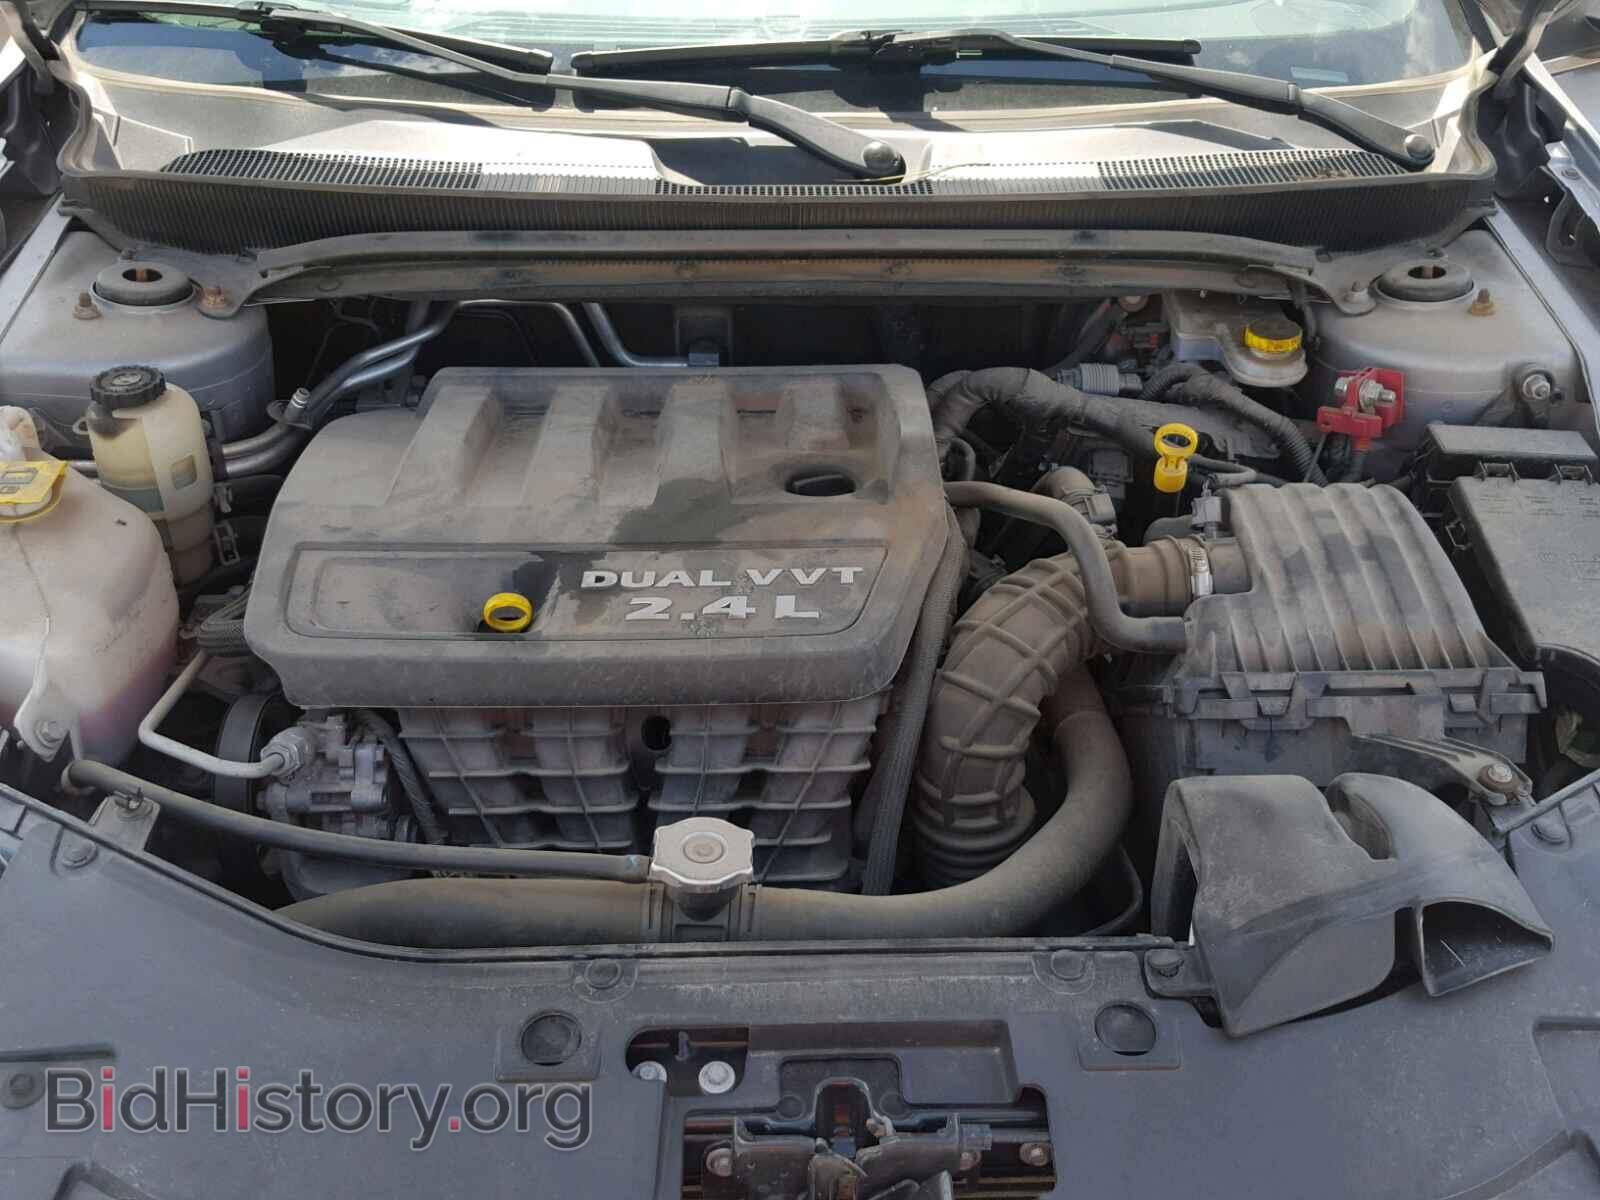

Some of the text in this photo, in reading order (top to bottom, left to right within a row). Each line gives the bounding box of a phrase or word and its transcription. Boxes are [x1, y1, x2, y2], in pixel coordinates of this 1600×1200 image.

[581, 566, 864, 588] DUAL VVT
[625, 594, 819, 620] 2.4 L
